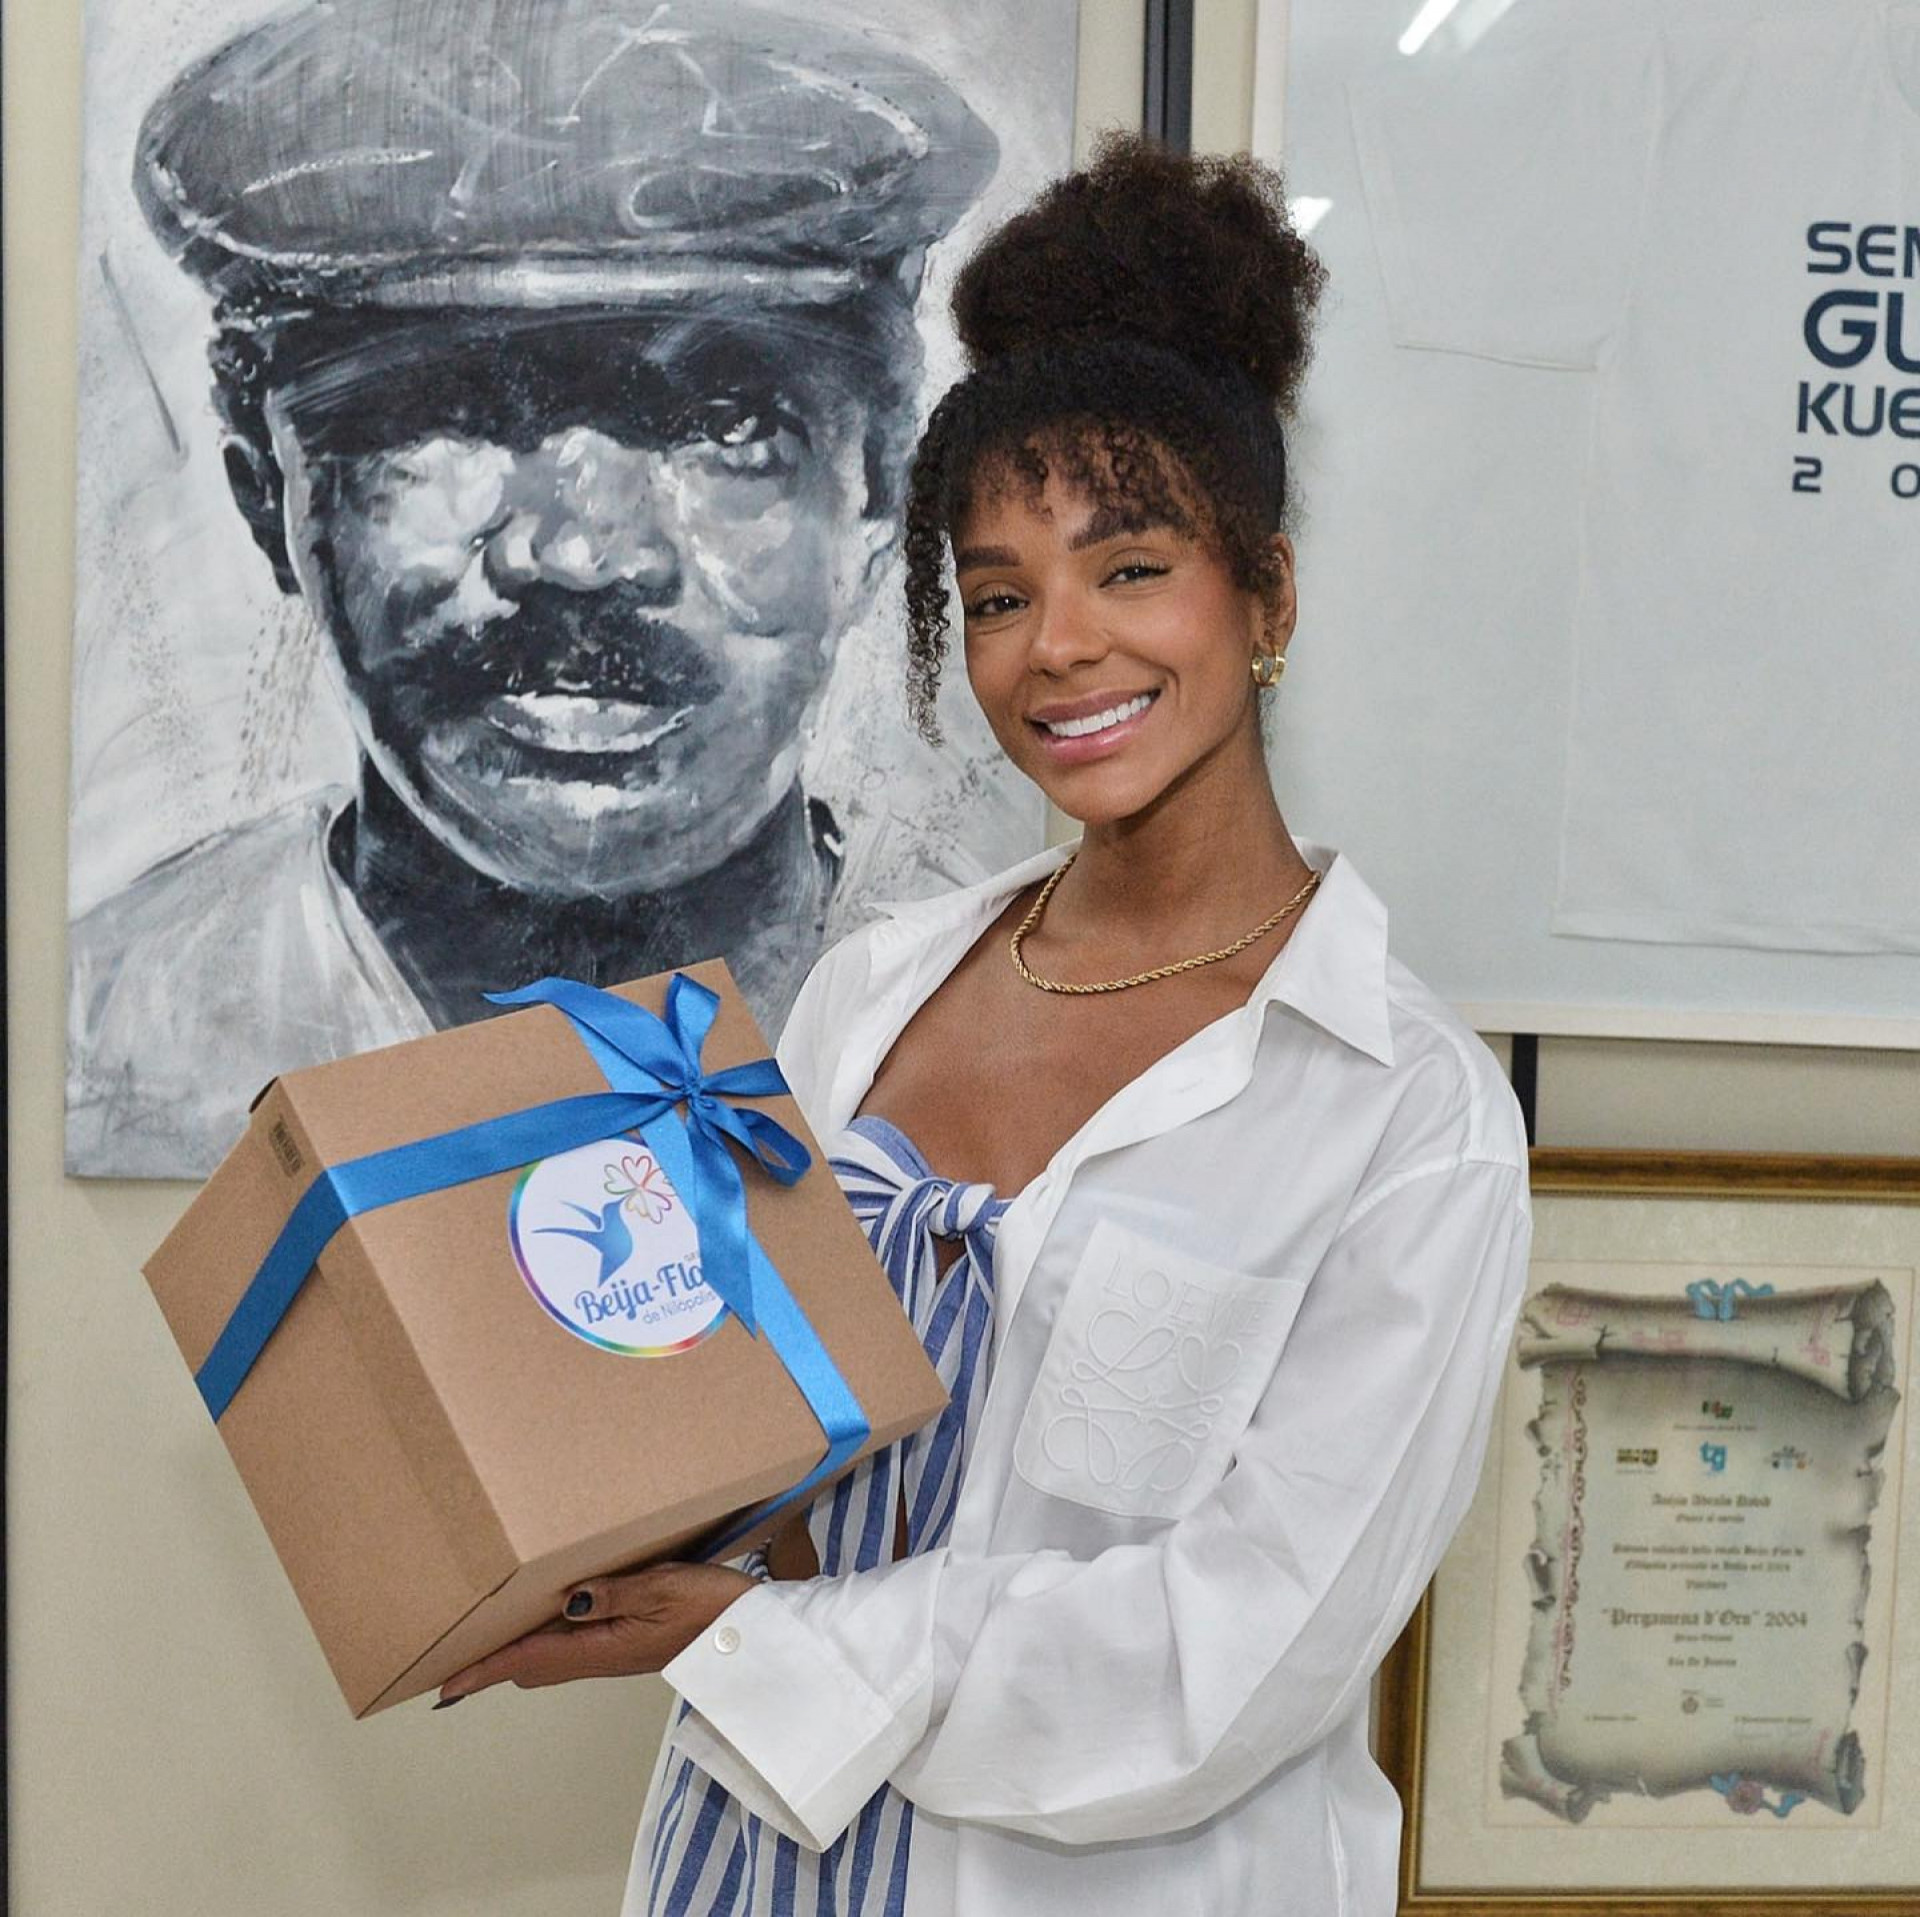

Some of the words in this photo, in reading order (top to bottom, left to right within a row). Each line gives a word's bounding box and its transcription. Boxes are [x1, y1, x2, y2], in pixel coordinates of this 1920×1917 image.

[574, 1262, 705, 1324] Beija-Flo
[642, 1308, 661, 1324] de
[1765, 1612, 1808, 1627] 2004
